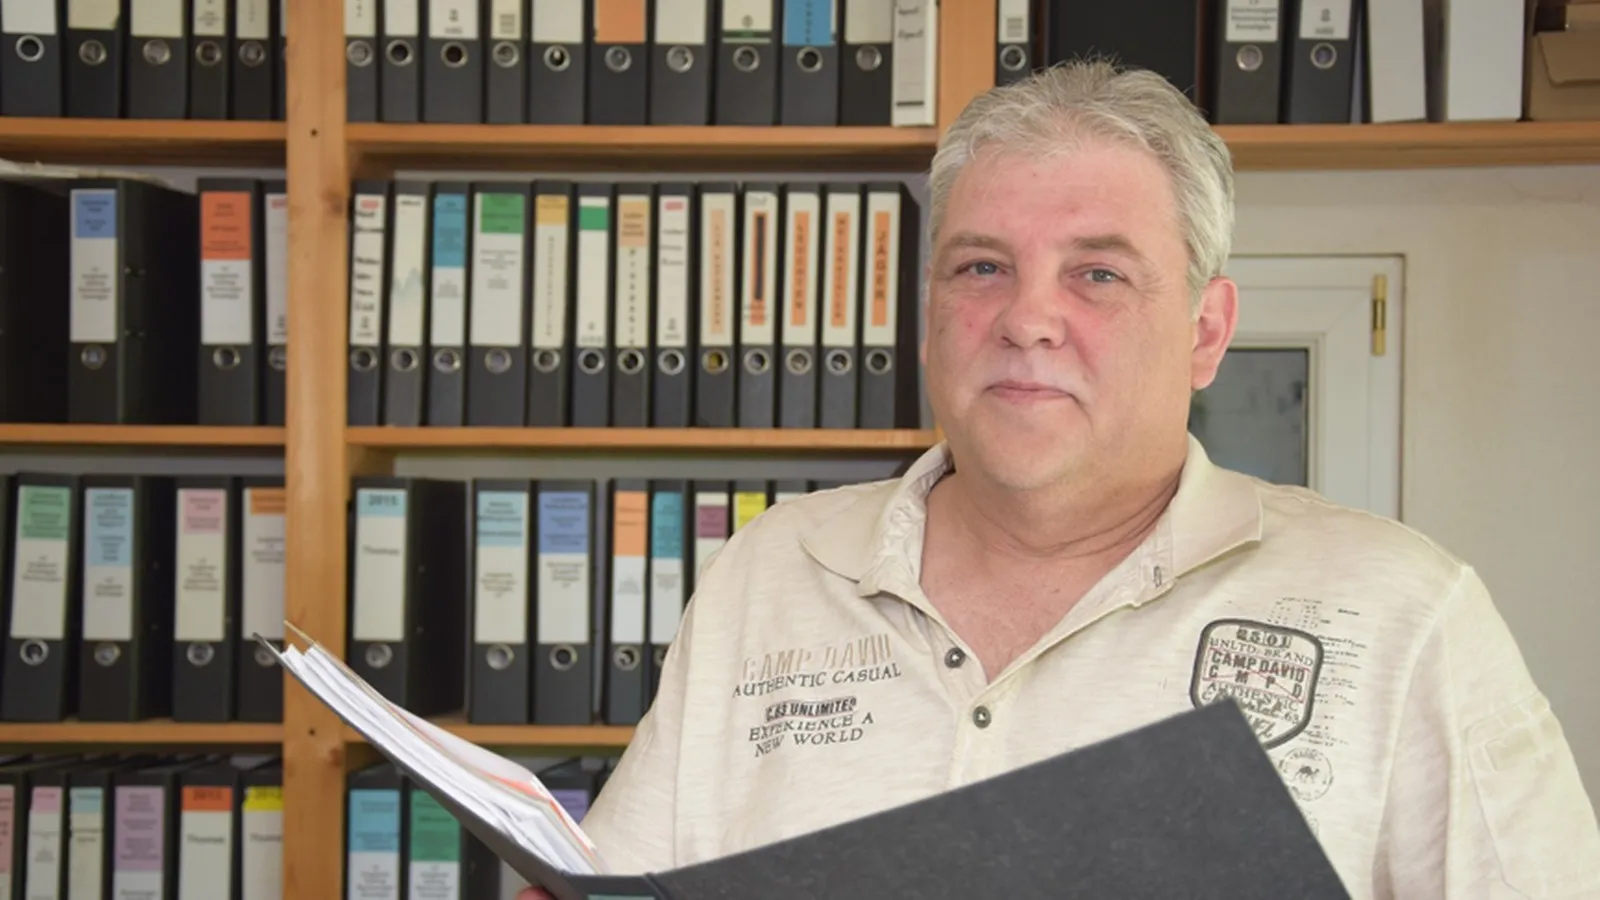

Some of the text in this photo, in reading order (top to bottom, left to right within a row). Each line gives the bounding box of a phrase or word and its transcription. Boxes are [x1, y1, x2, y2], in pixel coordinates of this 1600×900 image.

[742, 634, 893, 682] CAMP DAVID
[1211, 650, 1257, 671] CAMP
[1259, 658, 1305, 683] DAVID
[732, 662, 902, 699] AUTHENTIC CASUAL
[748, 711, 875, 742] EXPERIENCE A
[754, 727, 864, 758] NEW WORLD
